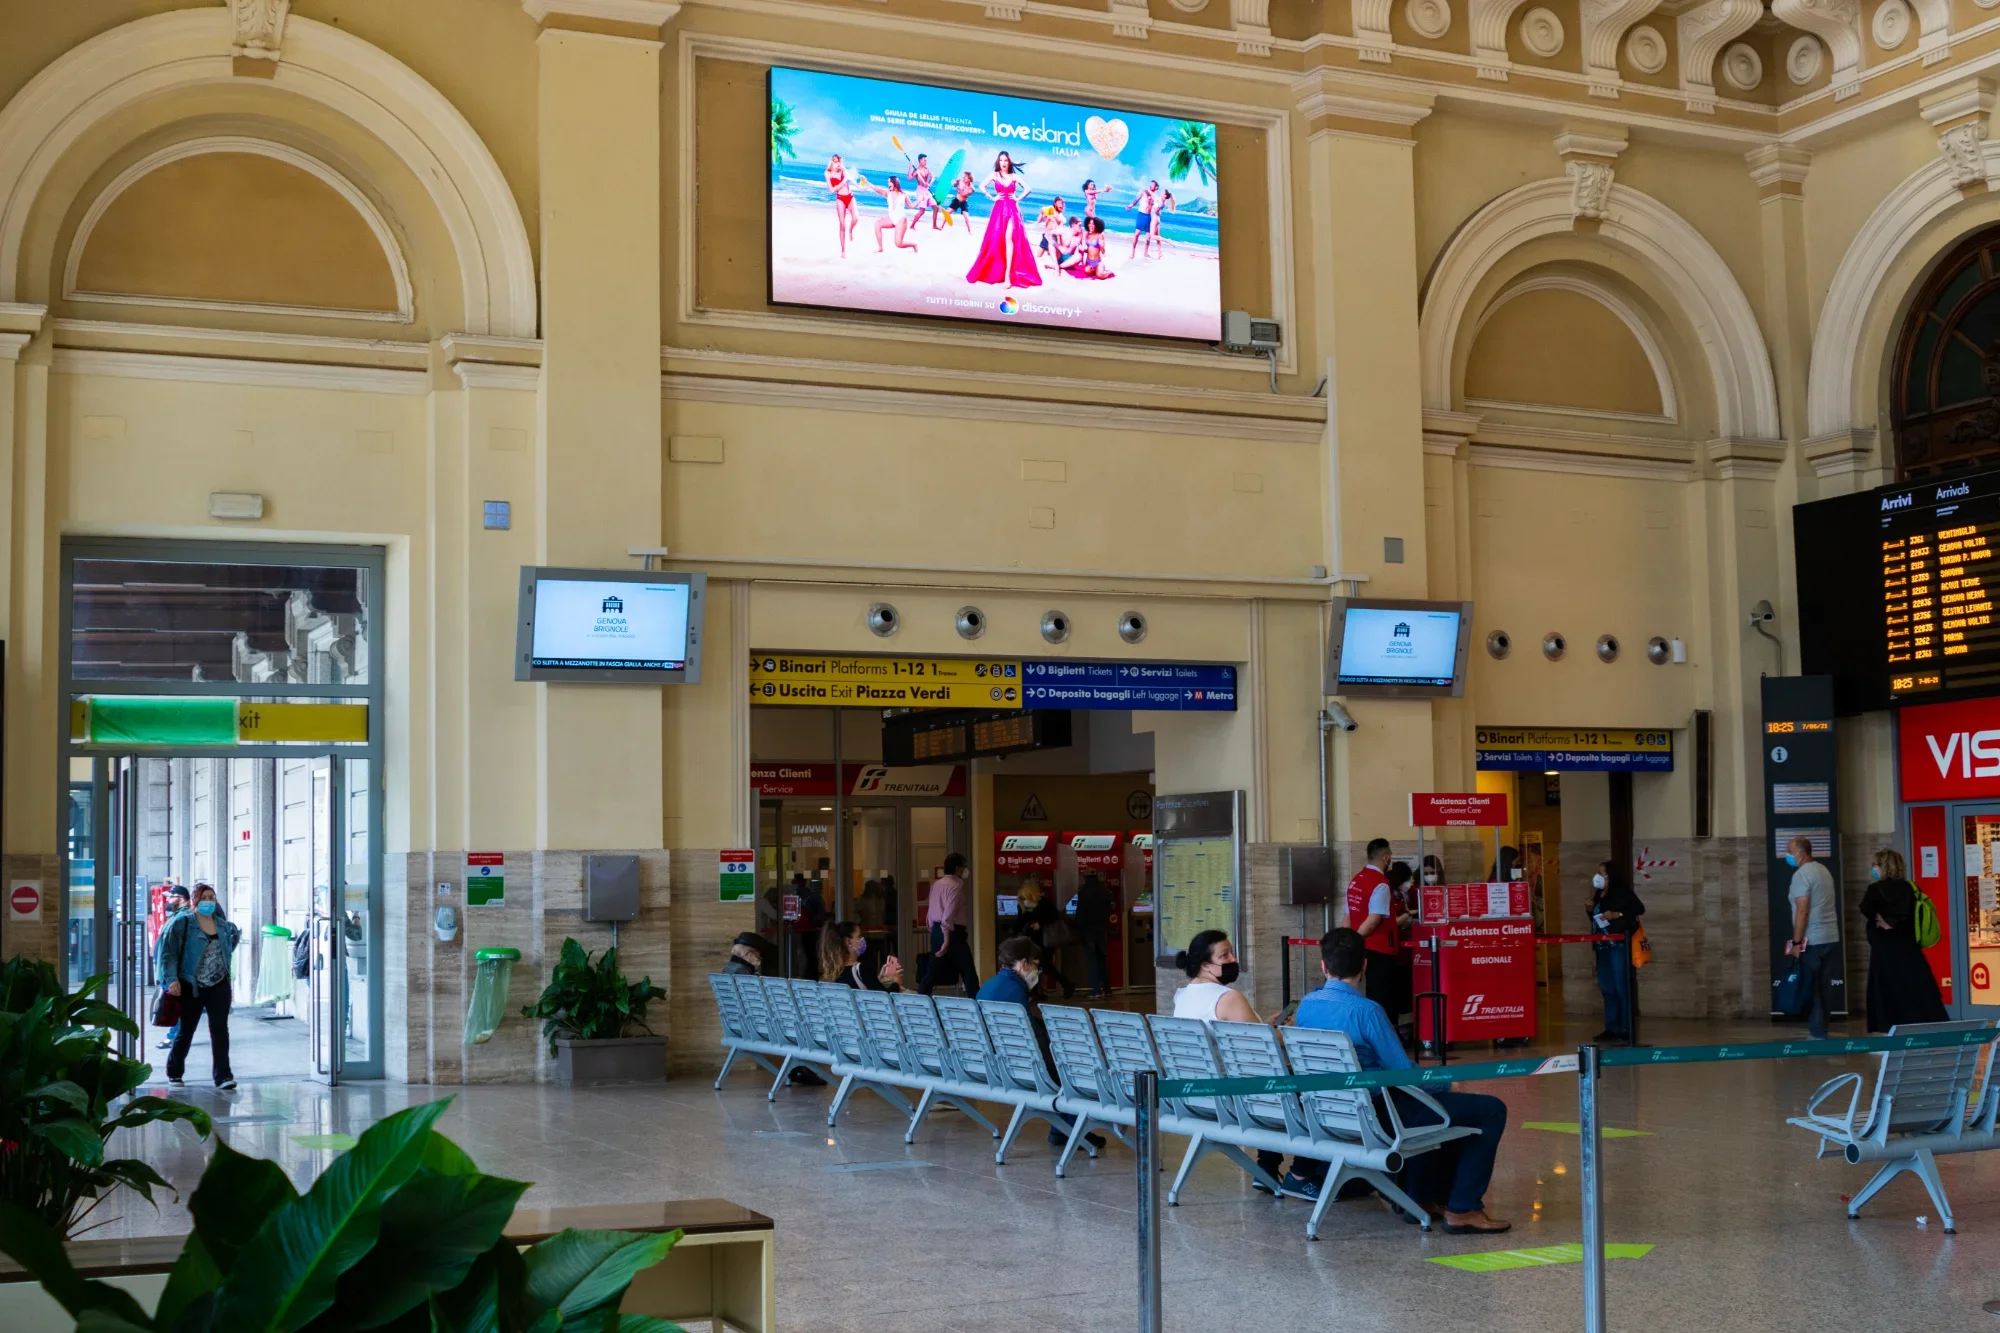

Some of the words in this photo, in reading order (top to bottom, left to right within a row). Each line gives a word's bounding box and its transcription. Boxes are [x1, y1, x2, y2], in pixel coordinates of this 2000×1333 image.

[870, 114, 886, 123] UNA
[887, 117, 906, 126] SERIE
[907, 118, 943, 130] ORIGINALE
[884, 109, 908, 118] GIULIA
[920, 113, 940, 122] LELLIS
[941, 116, 972, 125] PRESENTA
[992, 110, 1030, 140] love
[1032, 118, 1080, 146] island
[1052, 146, 1080, 158] ITALIA
[925, 296, 948, 306] TUTTI
[954, 299, 982, 308] GIORNI
[1022, 303, 1082, 317] discovery+
[1936, 482, 1970, 500] Arrivals
[1881, 493, 1912, 510] Arrivi
[780, 660, 826, 674] Binari
[830, 660, 888, 675] Platforms
[892, 662, 924, 676] 1-12
[931, 663, 938, 676] 1
[1048, 666, 1085, 676] Biglietti
[1088, 667, 1112, 676] Tickets
[1141, 667, 1172, 677] Servizi
[1176, 668, 1198, 678] Toilets
[780, 684, 826, 698] Uscita
[831, 684, 852, 698] Exit
[856, 685, 906, 700] Piazza
[910, 686, 950, 700] Verdi
[1048, 688, 1091, 701] Deposito
[1094, 690, 1130, 701] bagagli
[1132, 690, 1146, 700] Left
[1148, 690, 1178, 702] luggage
[1206, 691, 1234, 700] Metro
[239, 709, 260, 729] xit
[1490, 732, 1524, 744] Binari
[1528, 732, 1570, 746] Platforms
[1574, 734, 1598, 746] 1-12
[1484, 752, 1511, 761] Servizi
[1513, 752, 1532, 762] Toilets
[1566, 753, 1600, 763] Deposito
[1601, 753, 1630, 764] bagagli
[1632, 754, 1644, 762] Left
[1644, 754, 1670, 764] luggage
[1926, 729, 2000, 780] VIS
[778, 768, 812, 778] Clienti
[763, 784, 794, 794] Service
[884, 784, 940, 792] TRENITALIA
[1440, 806, 1467, 814] Customer
[1468, 806, 1482, 814] Care
[1008, 856, 1034, 864] Biglietti
[1450, 926, 1500, 936] Assistenza
[1502, 924, 1532, 934] Clienti
[1472, 956, 1512, 964] REGIONALE
[1481, 1006, 1524, 1014] TRENITALIA
